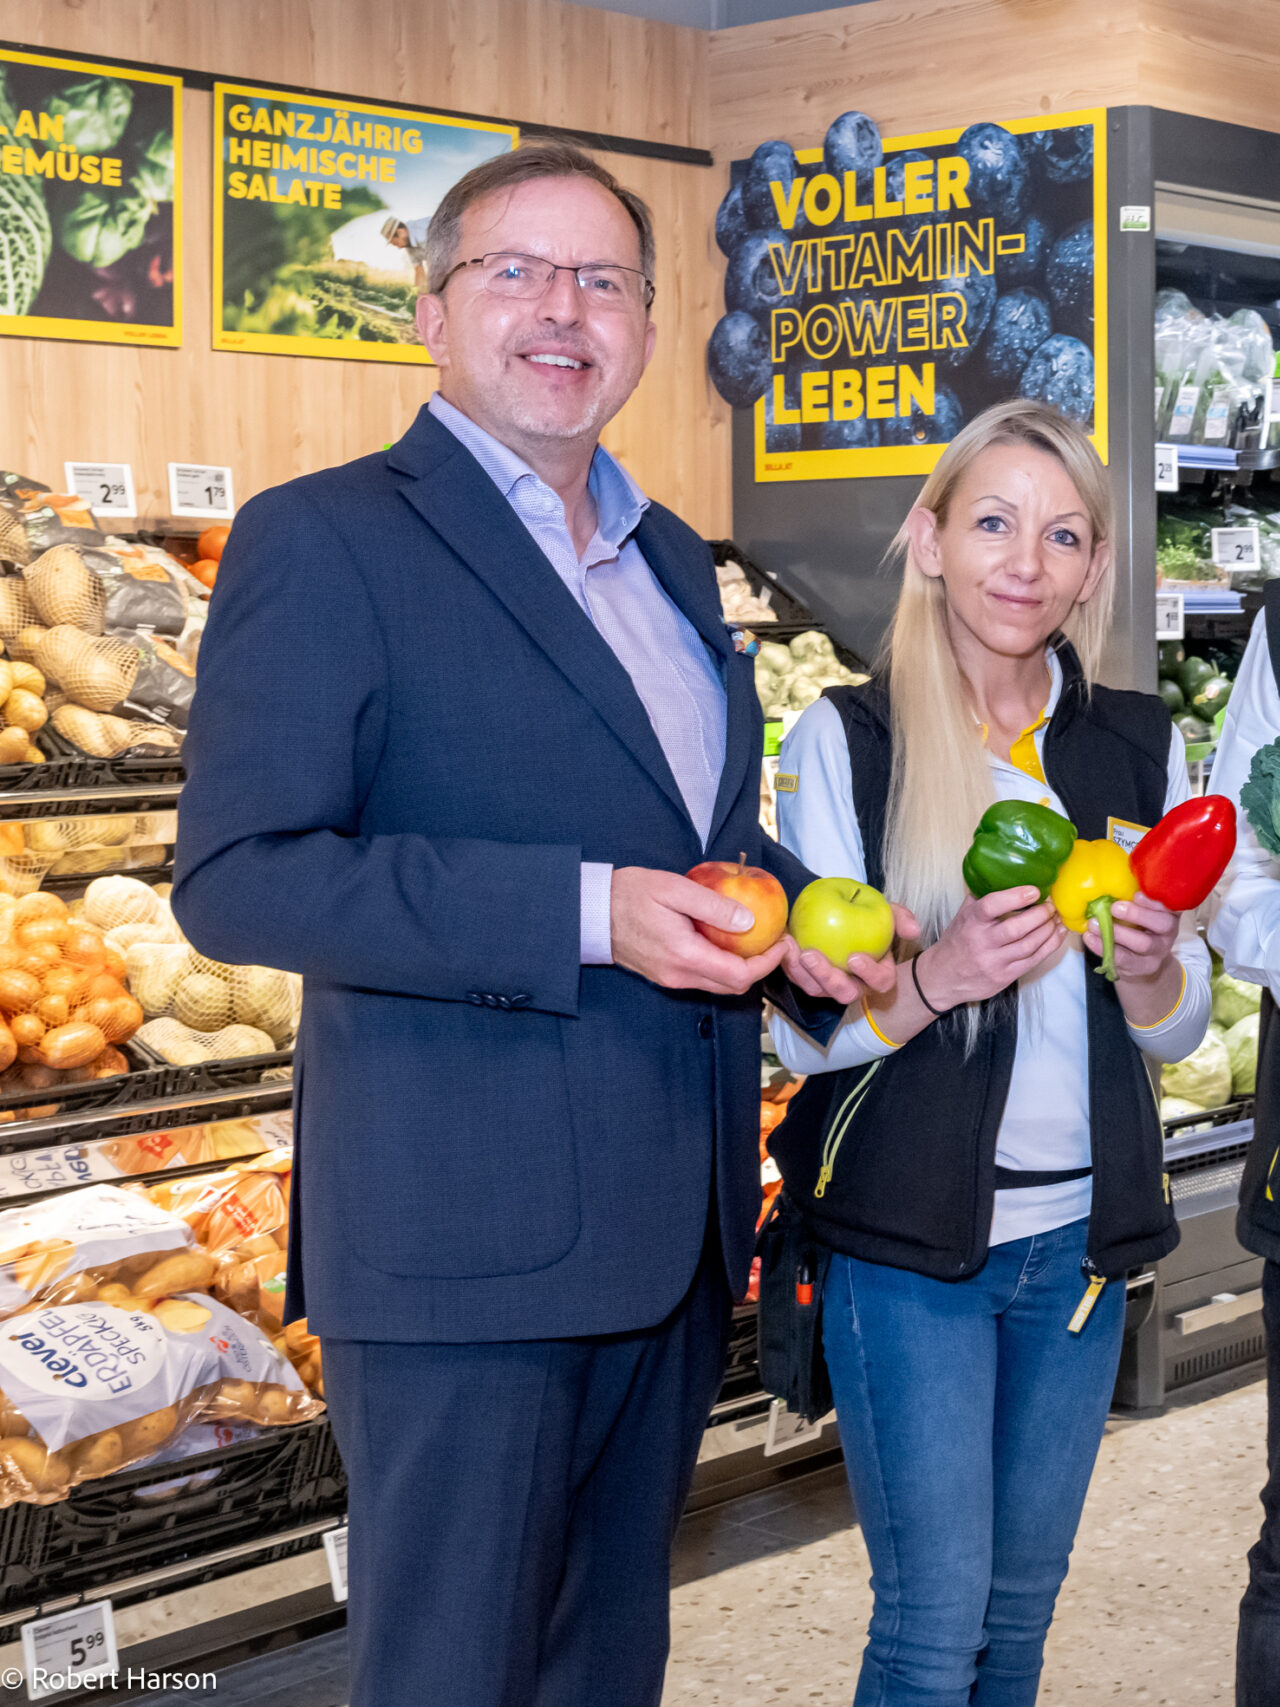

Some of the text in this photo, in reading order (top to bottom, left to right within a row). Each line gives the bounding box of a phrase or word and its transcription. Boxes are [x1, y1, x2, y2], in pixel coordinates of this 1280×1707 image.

[14, 110, 64, 142] AN
[229, 103, 423, 154] GANZJÄHRIG
[0, 143, 122, 187] EMÜSE
[229, 138, 397, 183] HEIMISCHE
[228, 173, 342, 210] SALATE
[768, 155, 972, 230] VOLLER
[768, 217, 1026, 296] VITAMIN-
[770, 292, 969, 363] POWER
[772, 363, 936, 425] LEBEN
[38, 1310, 132, 1394] ERDÄPFEL
